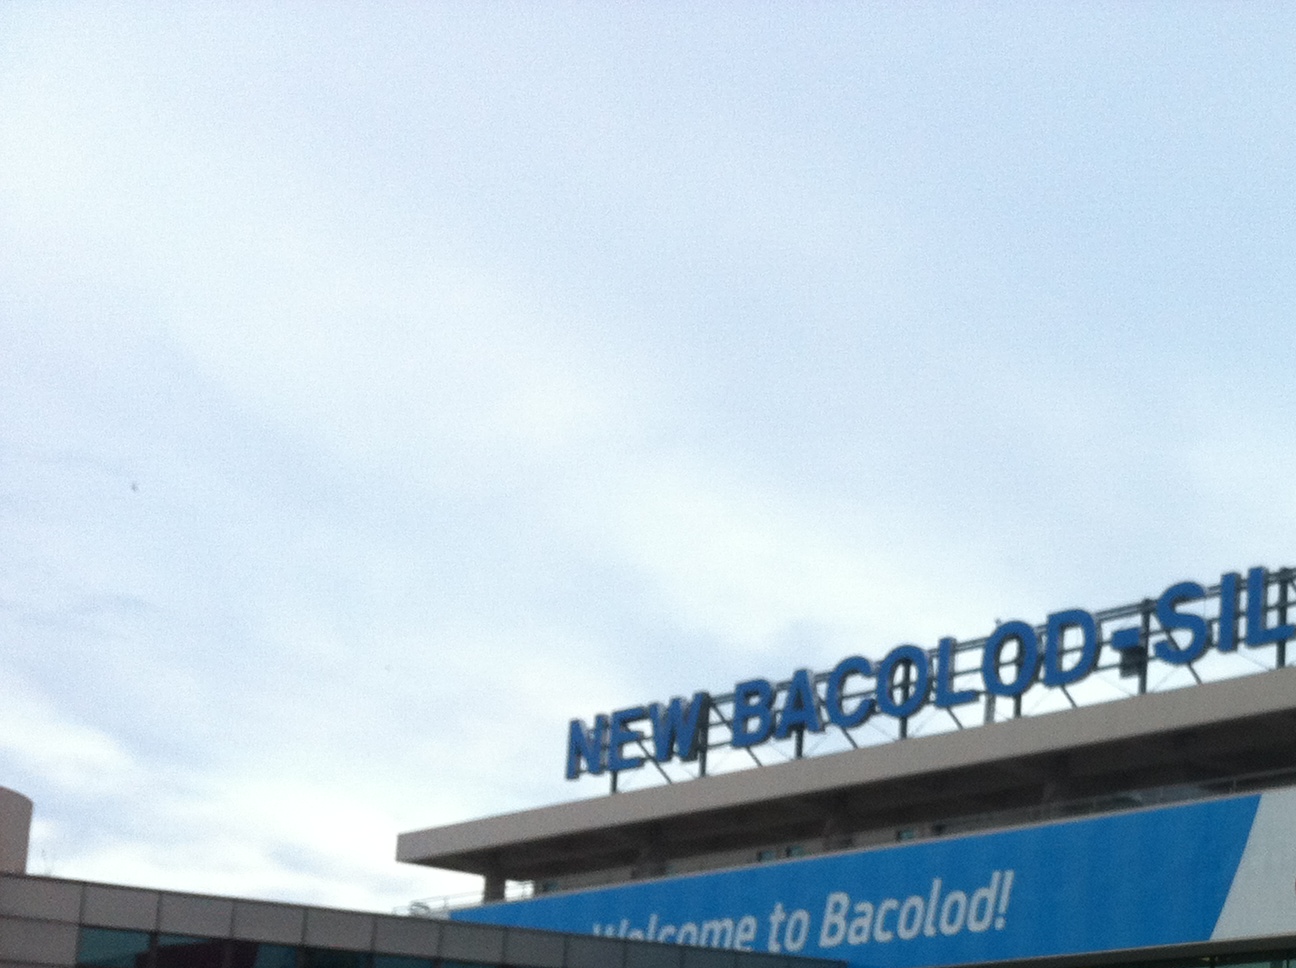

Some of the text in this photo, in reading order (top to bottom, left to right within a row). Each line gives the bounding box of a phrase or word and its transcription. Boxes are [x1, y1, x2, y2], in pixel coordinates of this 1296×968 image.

[566, 692, 707, 780] NEW
[768, 902, 811, 953] to
[819, 869, 1015, 948] Bacolod!
